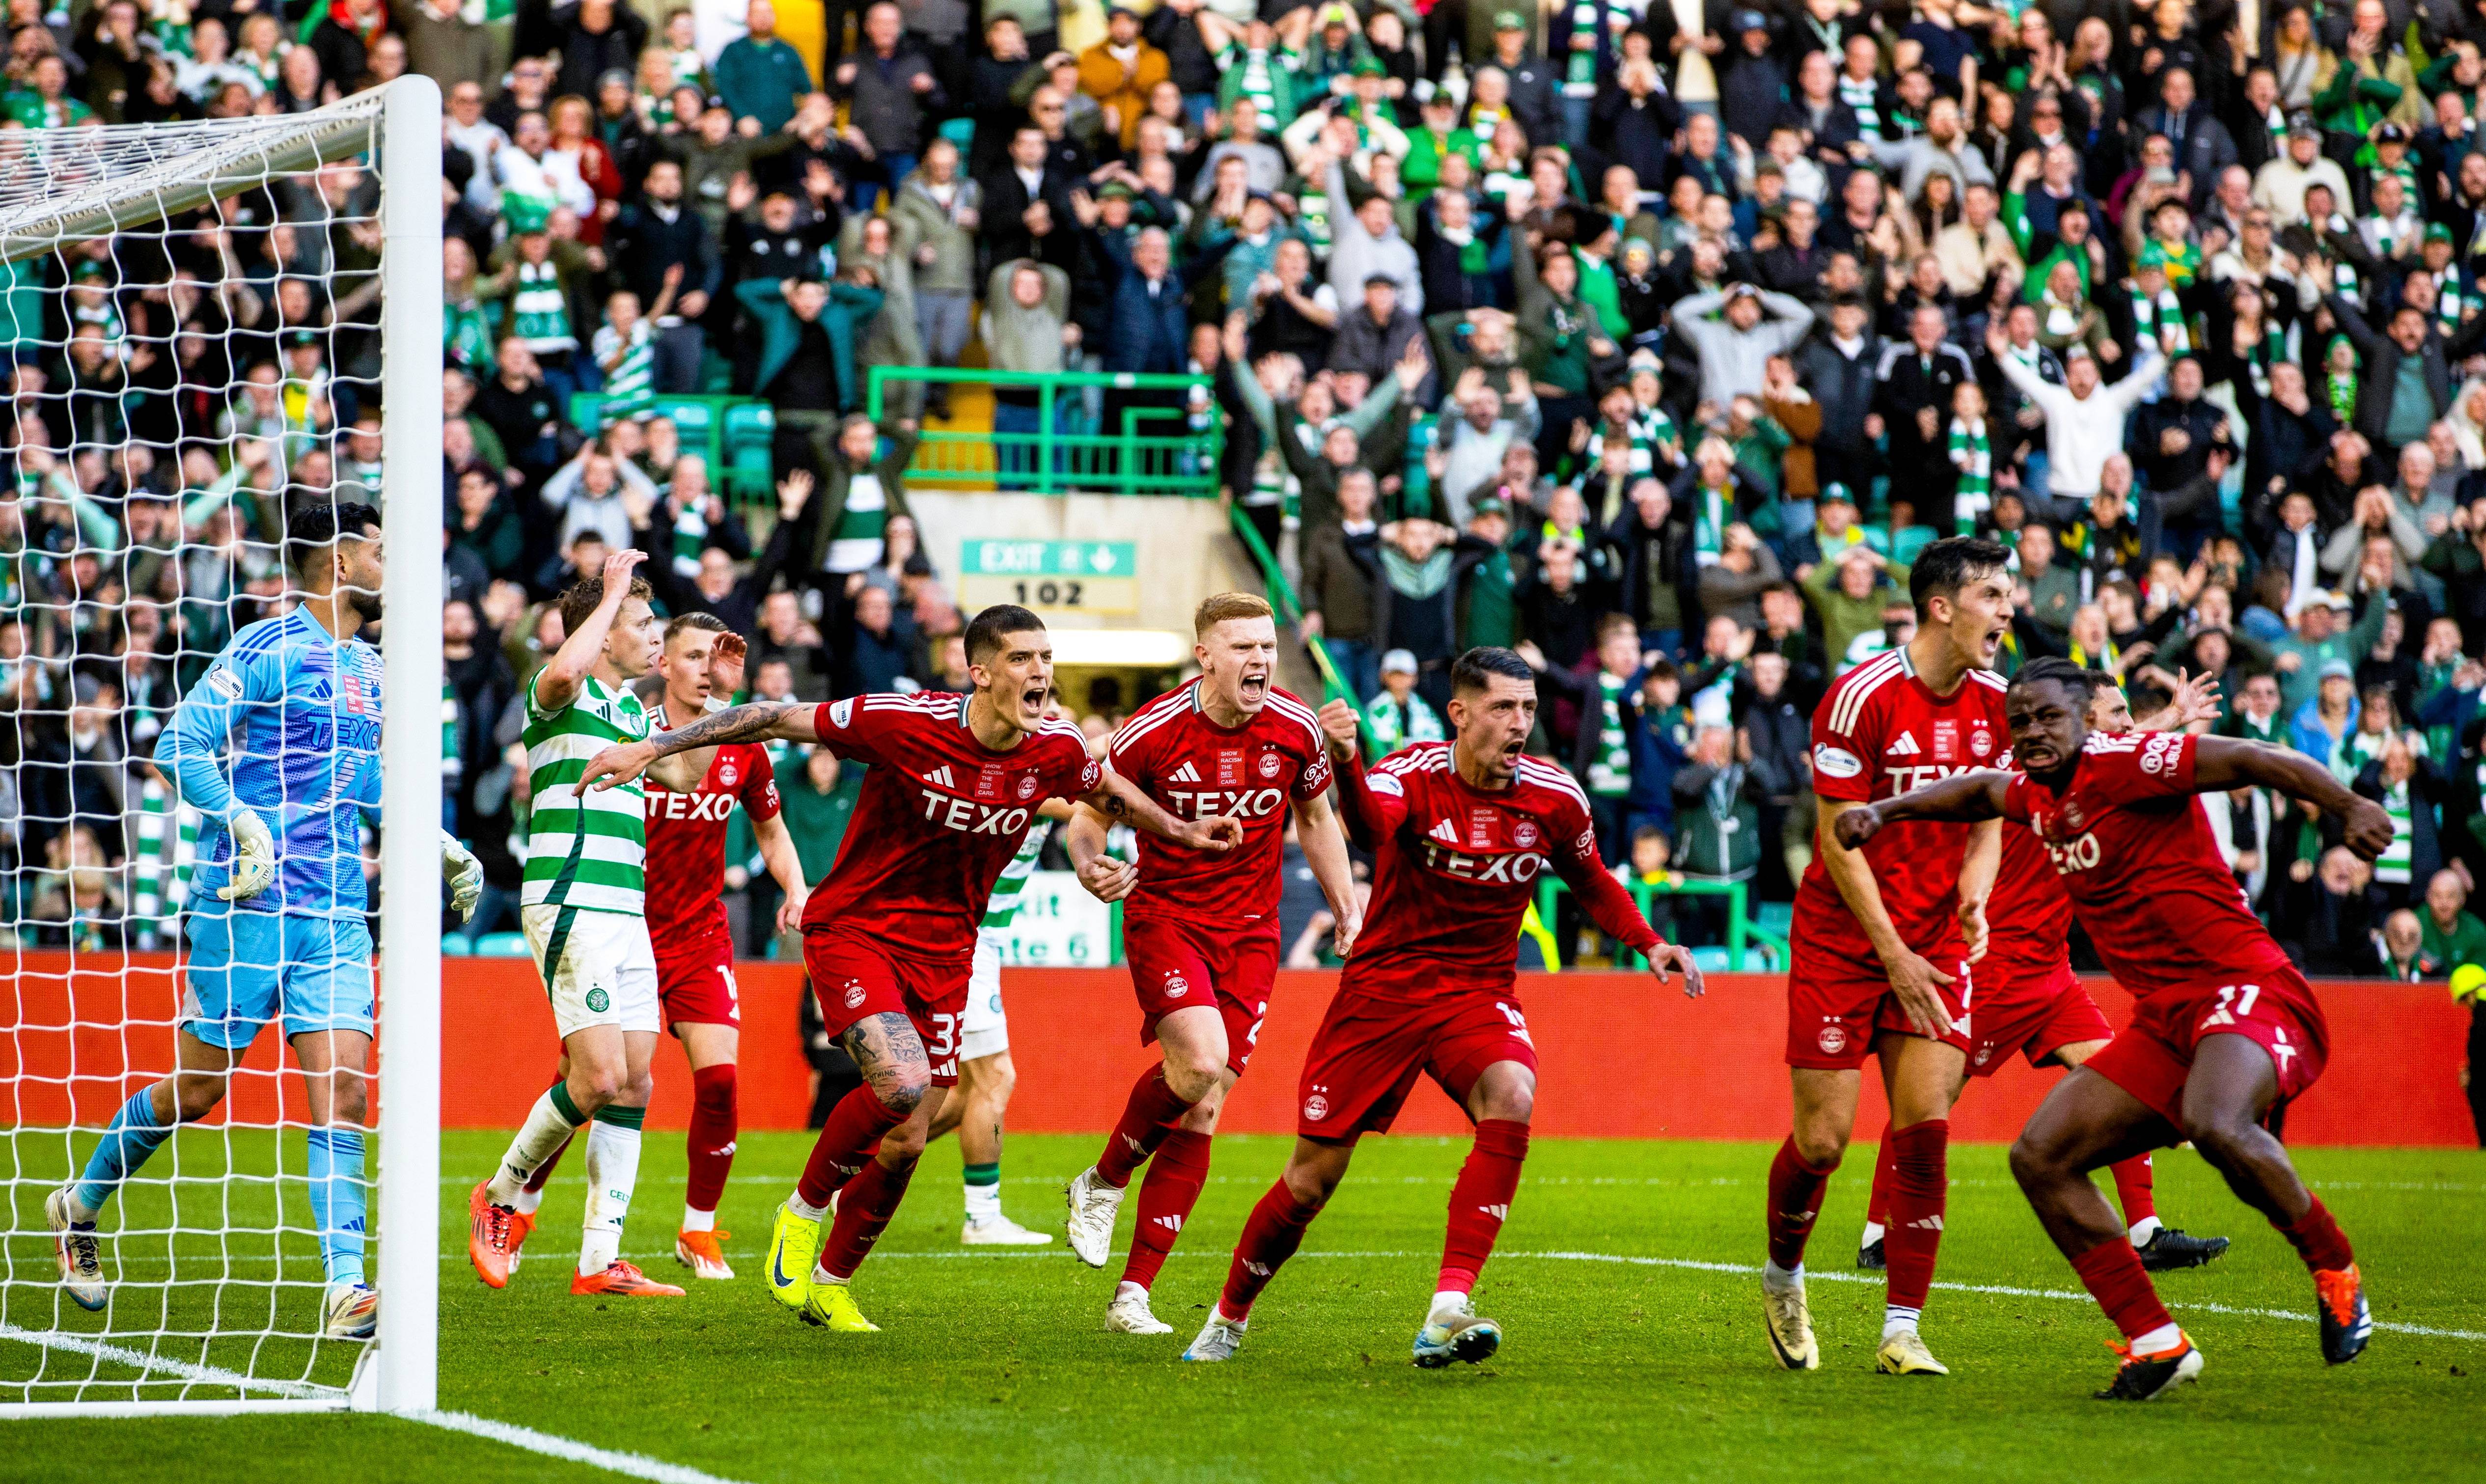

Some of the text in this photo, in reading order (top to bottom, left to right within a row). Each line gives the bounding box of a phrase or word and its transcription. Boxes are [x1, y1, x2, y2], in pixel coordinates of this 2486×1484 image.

[980, 542, 1045, 571] EXIT
[1015, 581, 1084, 605] 102
[231, 682, 242, 693] HILL
[305, 714, 384, 751] TEXO
[644, 790, 735, 821] TEXO
[922, 789, 1028, 835] TEXO
[1168, 788, 1282, 820] TEXO
[1421, 839, 1541, 882] TEXO
[1068, 933, 1089, 963] 6
[610, 1189, 630, 1203] CELT
